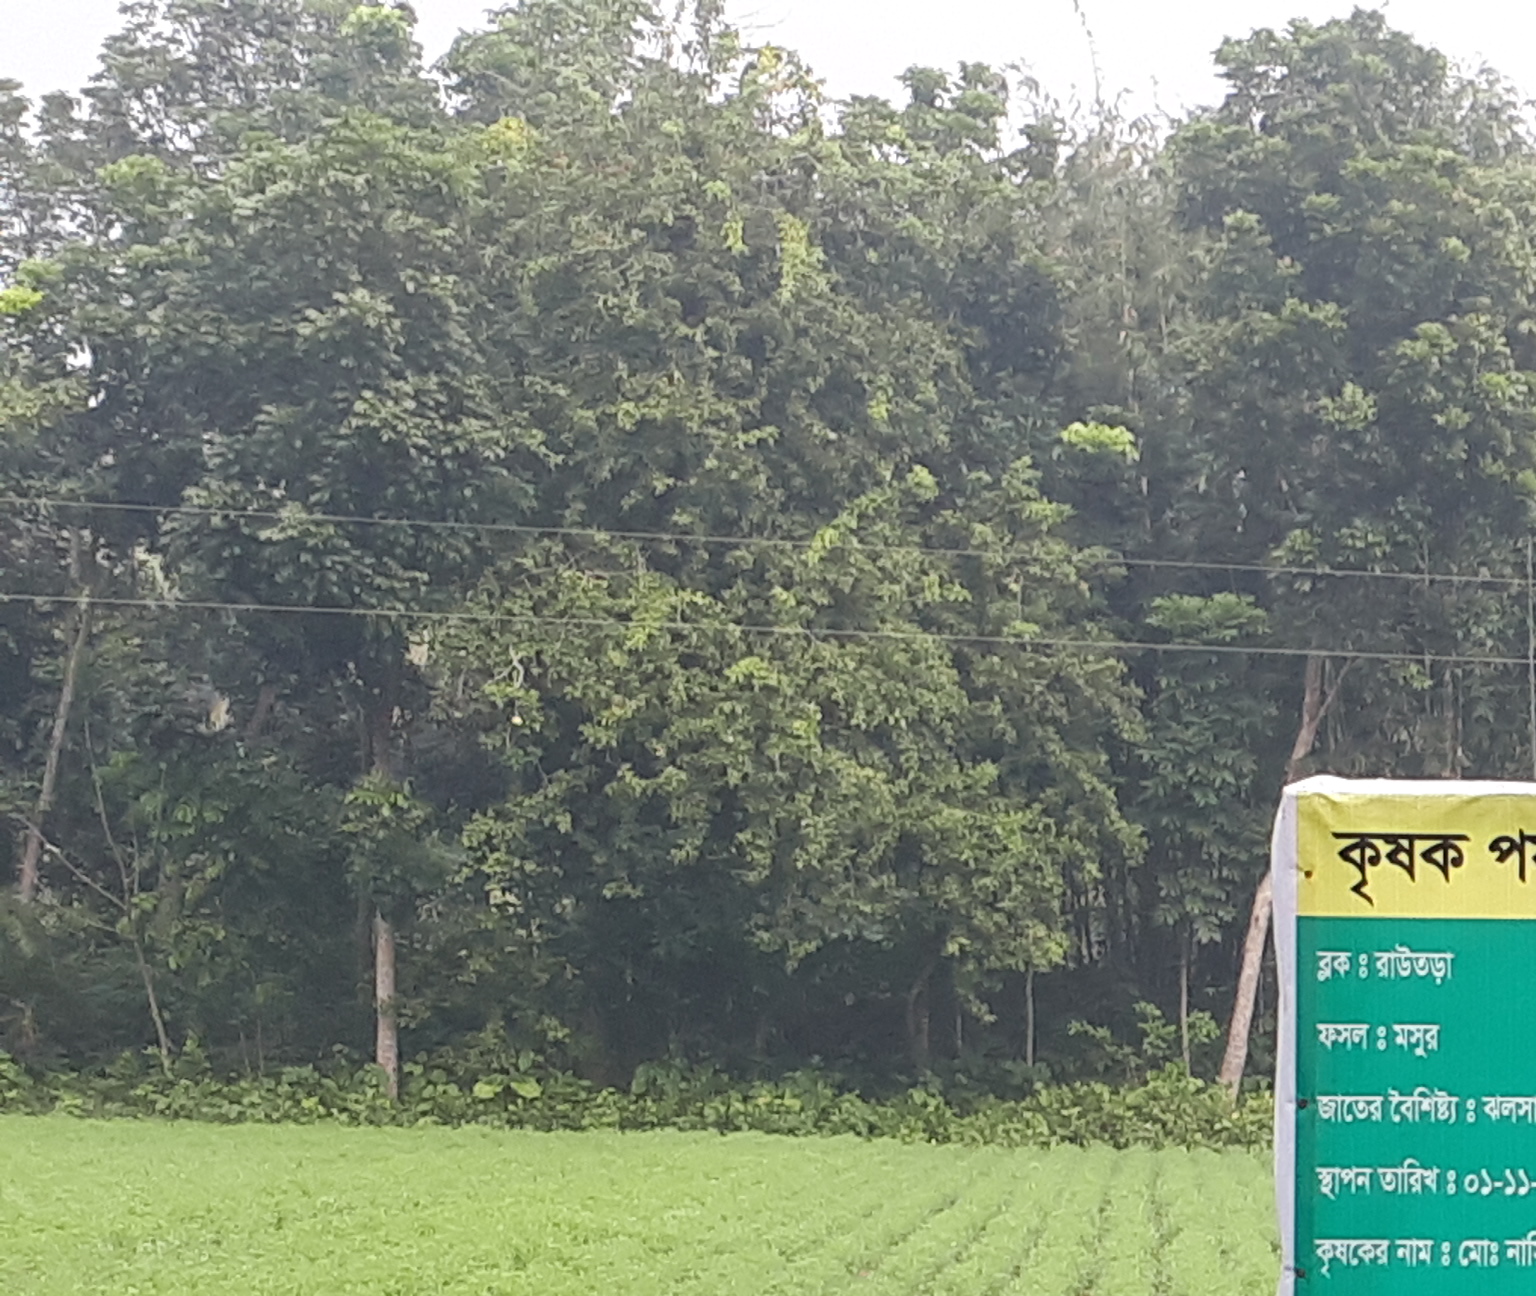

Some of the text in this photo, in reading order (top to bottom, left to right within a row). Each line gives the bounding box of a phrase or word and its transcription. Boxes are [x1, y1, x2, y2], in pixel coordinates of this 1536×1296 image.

[1331, 831, 1470, 905] কৃষক
[1315, 950, 1352, 982] ব্লক
[1373, 943, 1455, 985] রাউতড়া
[1315, 1023, 1371, 1049] ফসল
[1391, 1023, 1441, 1057] মসুর
[1315, 1094, 1385, 1123] জাতের
[1315, 1166, 1375, 1200] স্থাপন
[1376, 1157, 1441, 1194] তারিখ
[1313, 1238, 1391, 1276] কৃষকের
[1394, 1238, 1435, 1266] নাম
[1458, 1239, 1500, 1267] মোঃ
